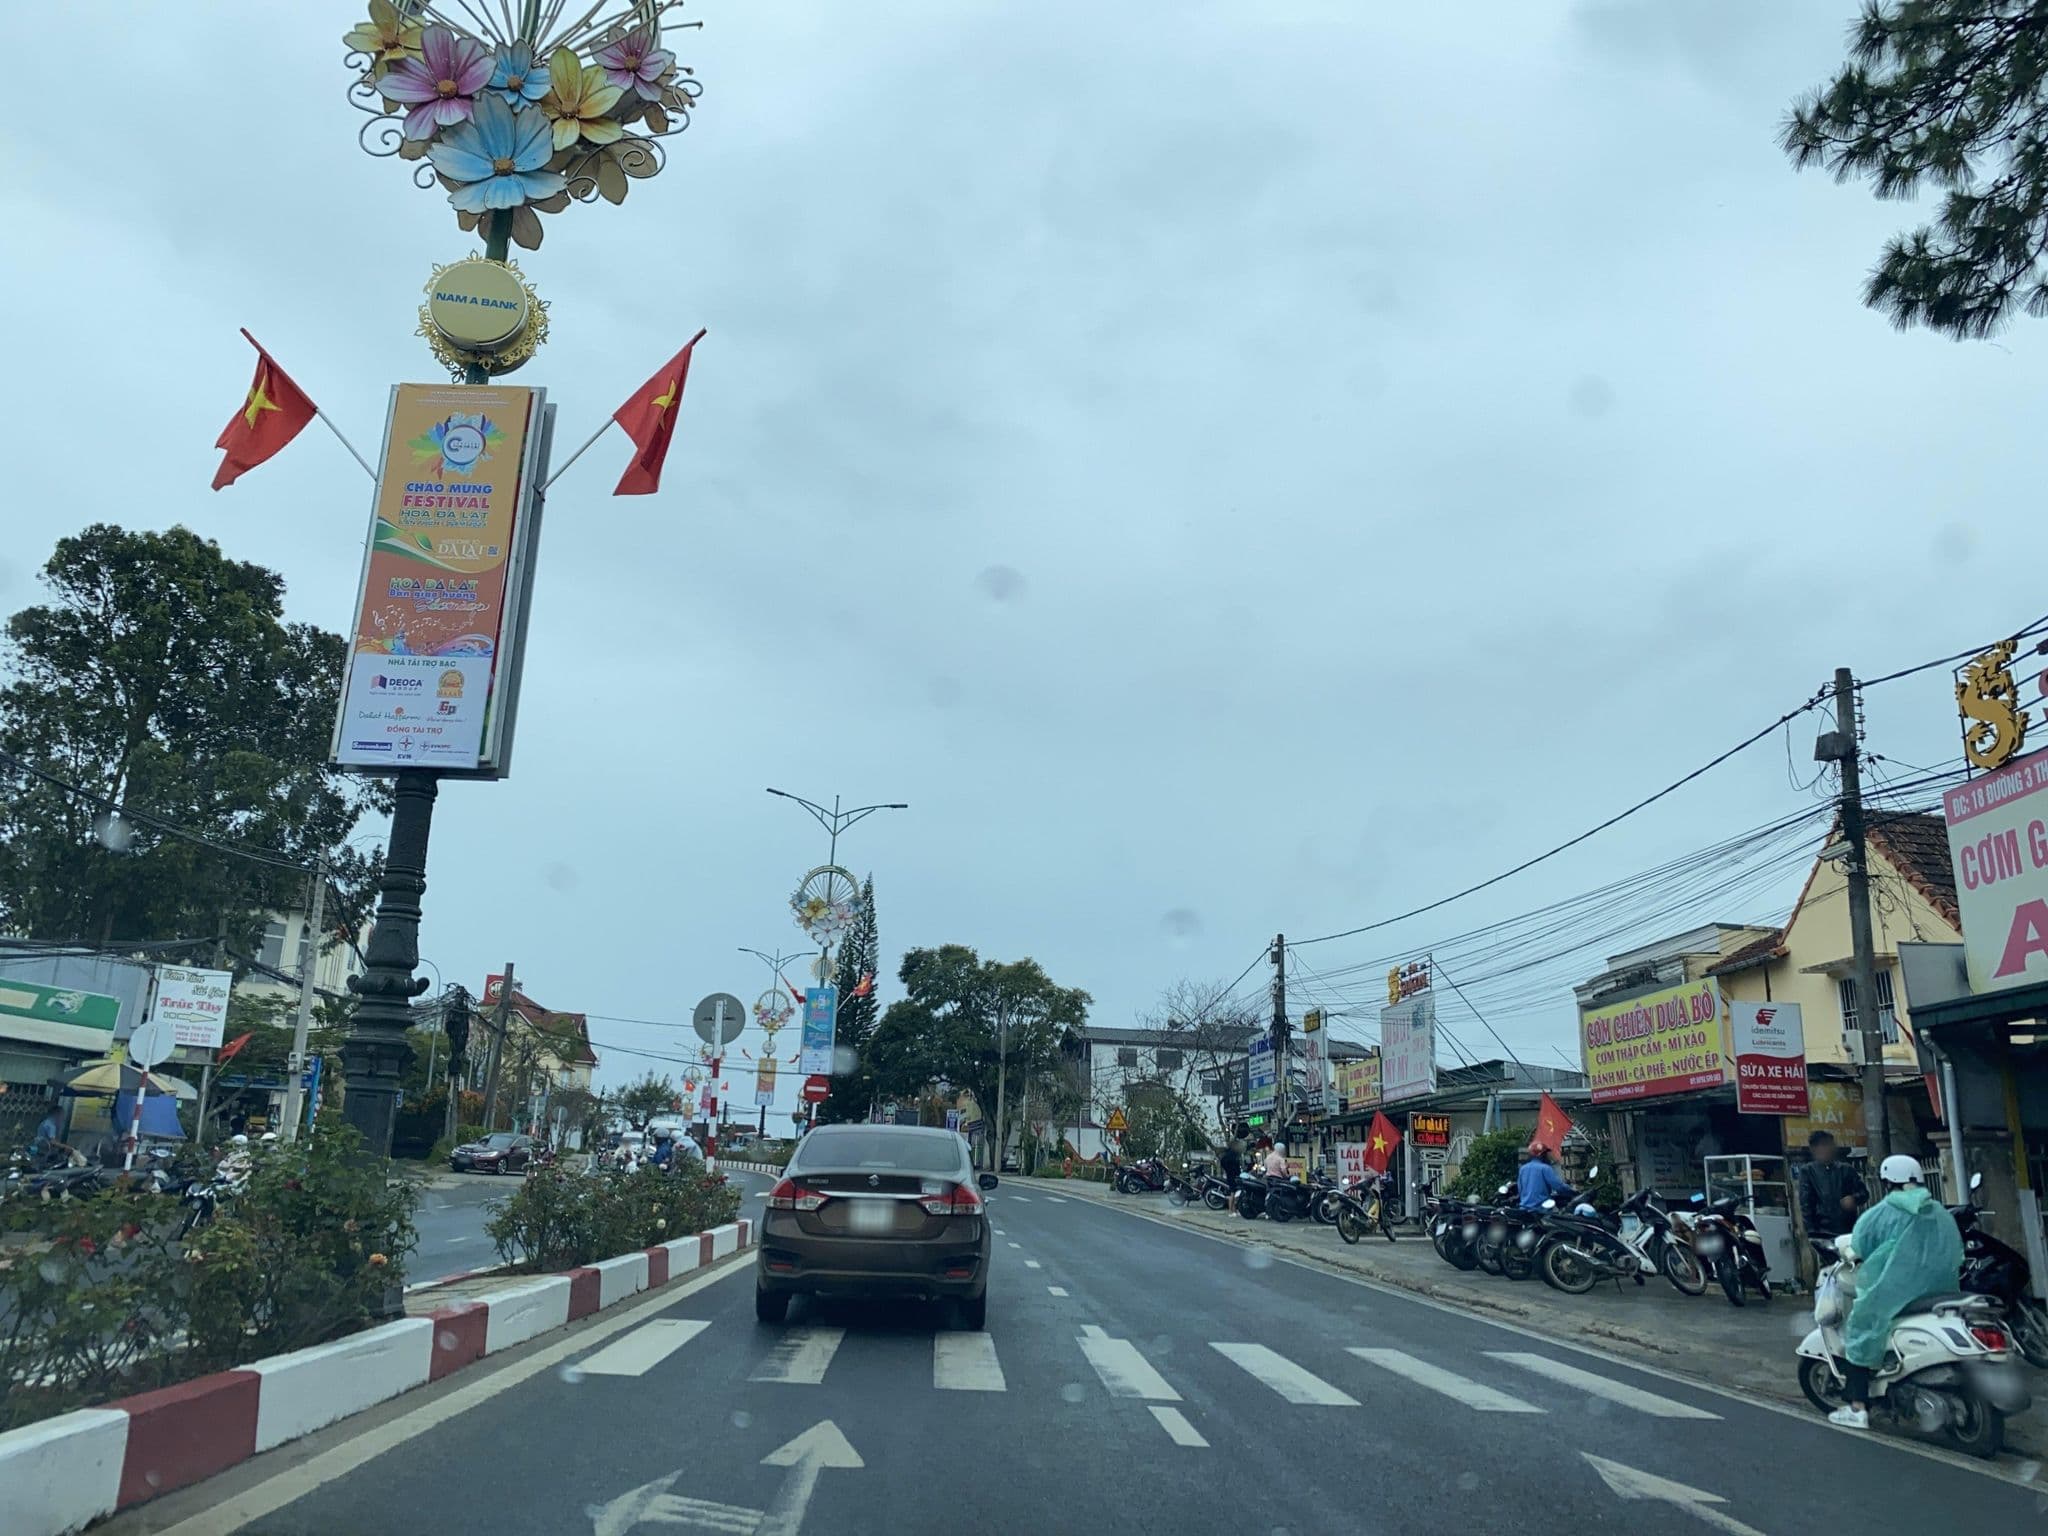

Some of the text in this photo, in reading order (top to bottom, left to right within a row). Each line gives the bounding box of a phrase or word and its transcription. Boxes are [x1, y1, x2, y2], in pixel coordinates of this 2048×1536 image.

[436, 292, 467, 304] NAM
[481, 298, 518, 310] BANK
[403, 495, 490, 509] FESTIVAL
[401, 510, 430, 518] HOA
[389, 679, 422, 687] DEOCA
[1971, 788, 1984, 808] 18
[1986, 772, 2022, 803] ĐƯỜNG
[2024, 767, 2033, 788] 3
[1961, 829, 2023, 890] CƠM
[1587, 1017, 1612, 1048] CƠM
[1614, 1002, 1655, 1042] CHIÊN
[1657, 995, 1689, 1032] DƯA
[1751, 1026, 1785, 1035] idemitsu
[1683, 1030, 1706, 1048] XÀO
[1741, 1062, 1766, 1076] SỬA
[1768, 1066, 1783, 1077] XE
